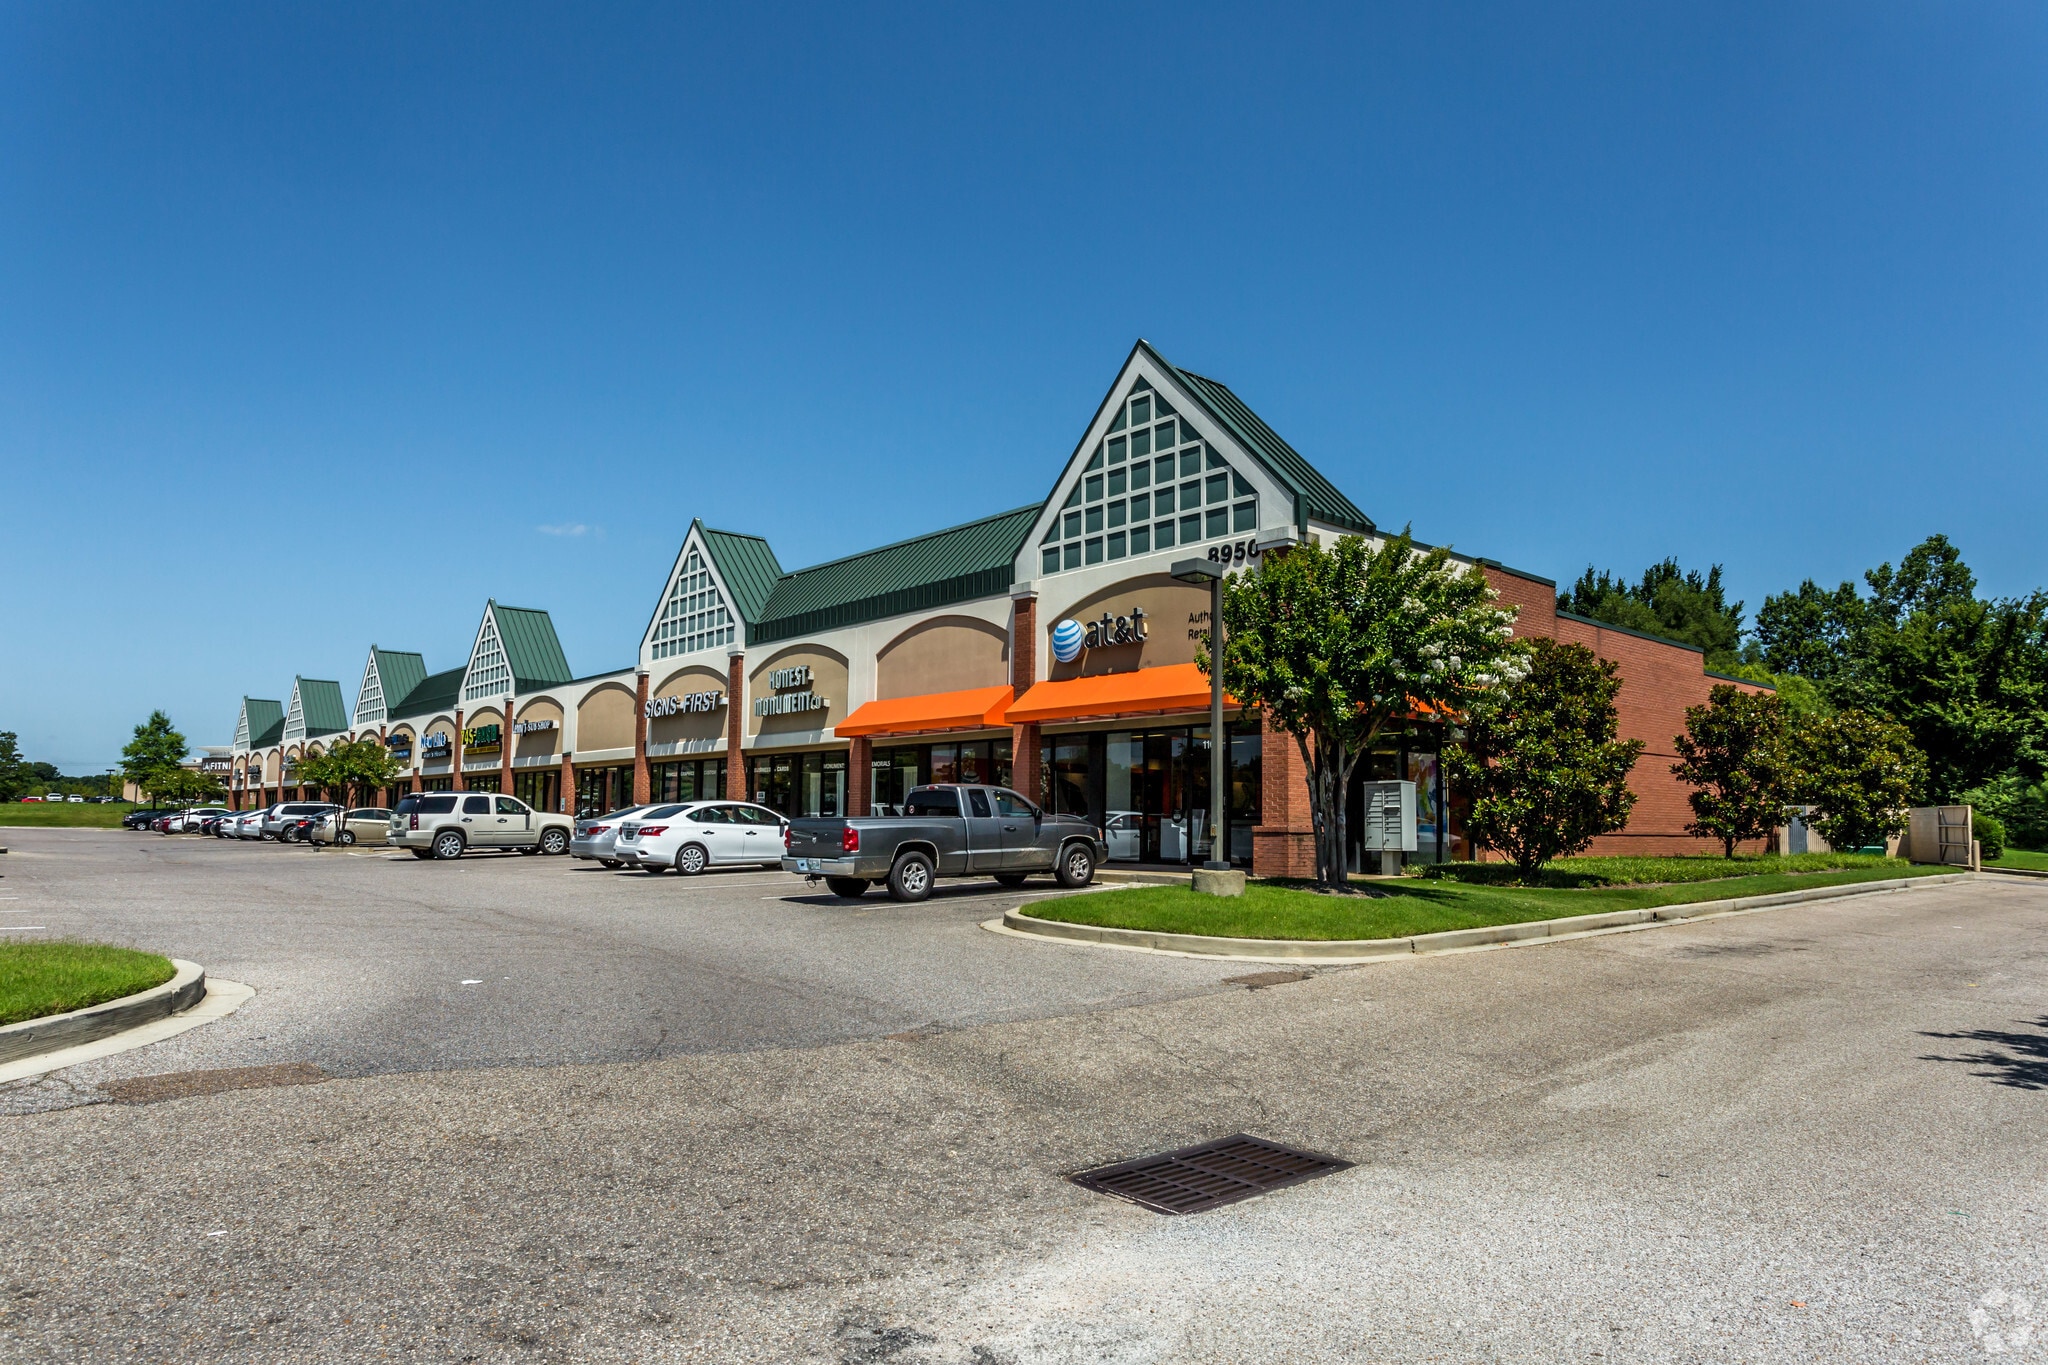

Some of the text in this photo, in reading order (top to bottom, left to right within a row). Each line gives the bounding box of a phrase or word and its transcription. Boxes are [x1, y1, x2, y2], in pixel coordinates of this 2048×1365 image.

[1208, 538, 1260, 563] 8950
[1084, 607, 1146, 649] at&t
[768, 665, 809, 690] HONEST
[644, 690, 721, 719] SIGNS FIRST
[754, 691, 813, 718] MONUMENT
[1202, 740, 1212, 749] 11
